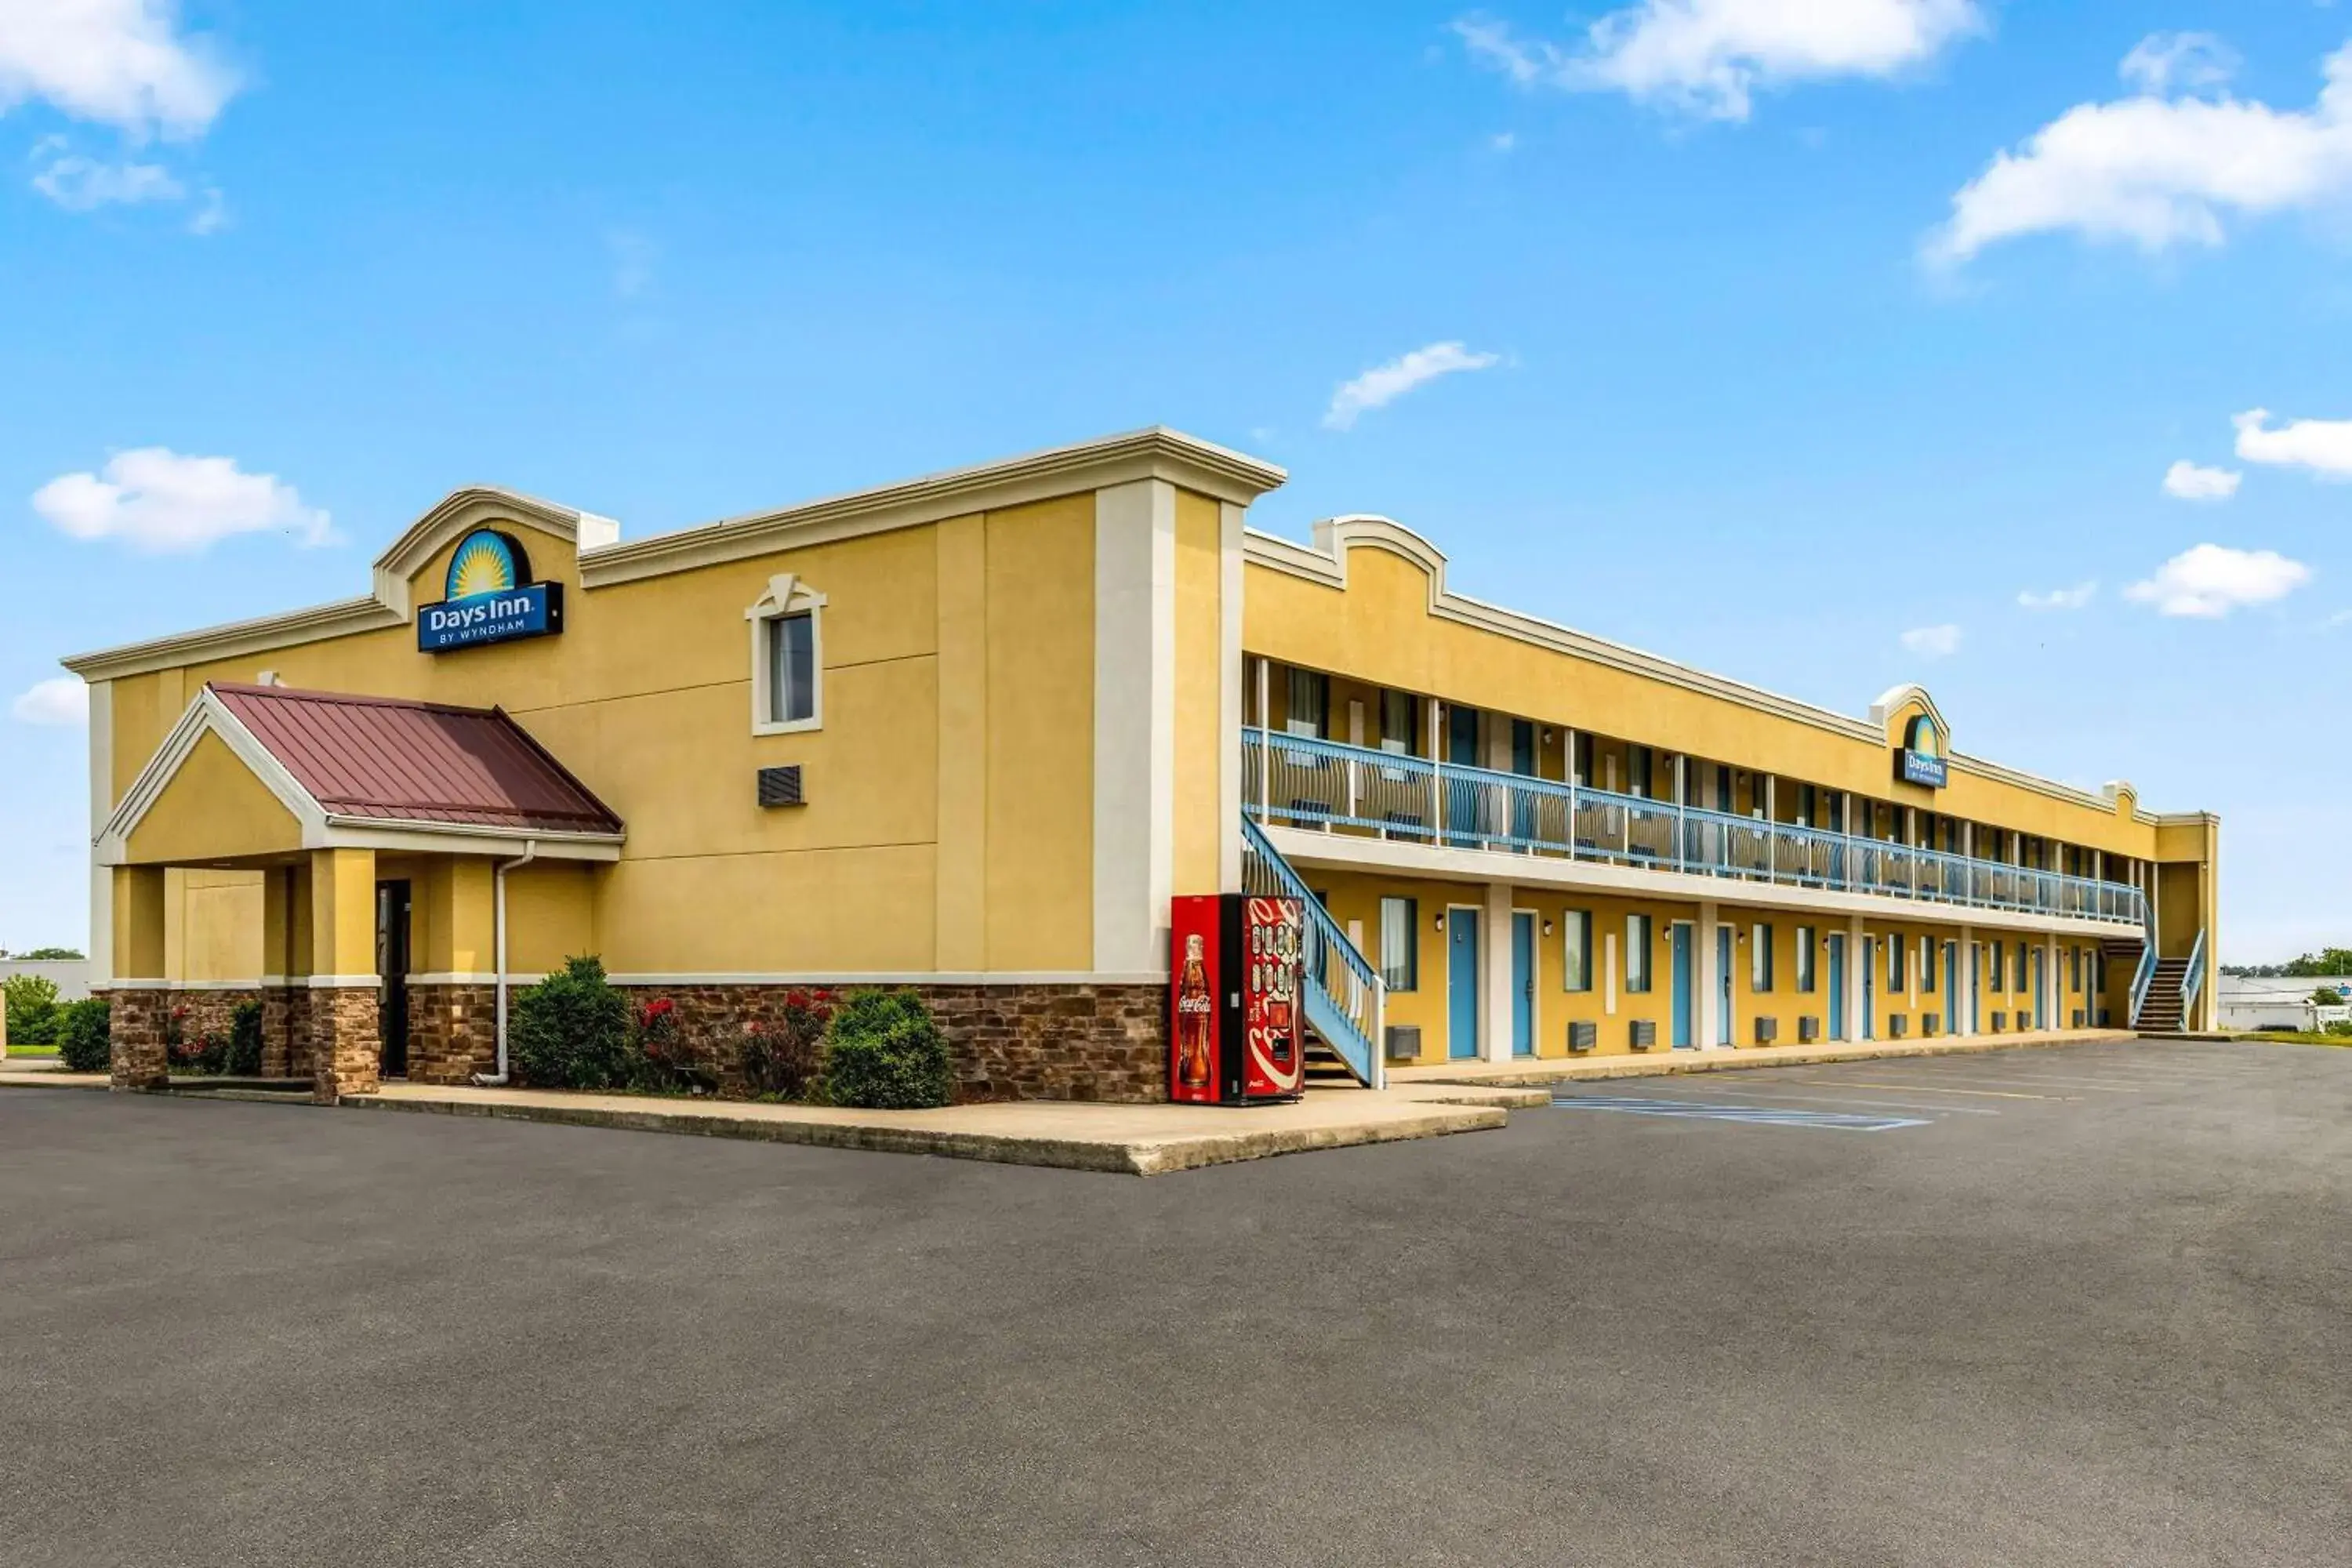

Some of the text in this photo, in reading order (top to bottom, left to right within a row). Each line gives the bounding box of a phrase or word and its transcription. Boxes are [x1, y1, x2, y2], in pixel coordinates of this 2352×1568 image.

[430, 597, 530, 630] Days Inn
[440, 619, 524, 644] BY WYNDHAM
[1909, 755, 1942, 775] Days Inn
